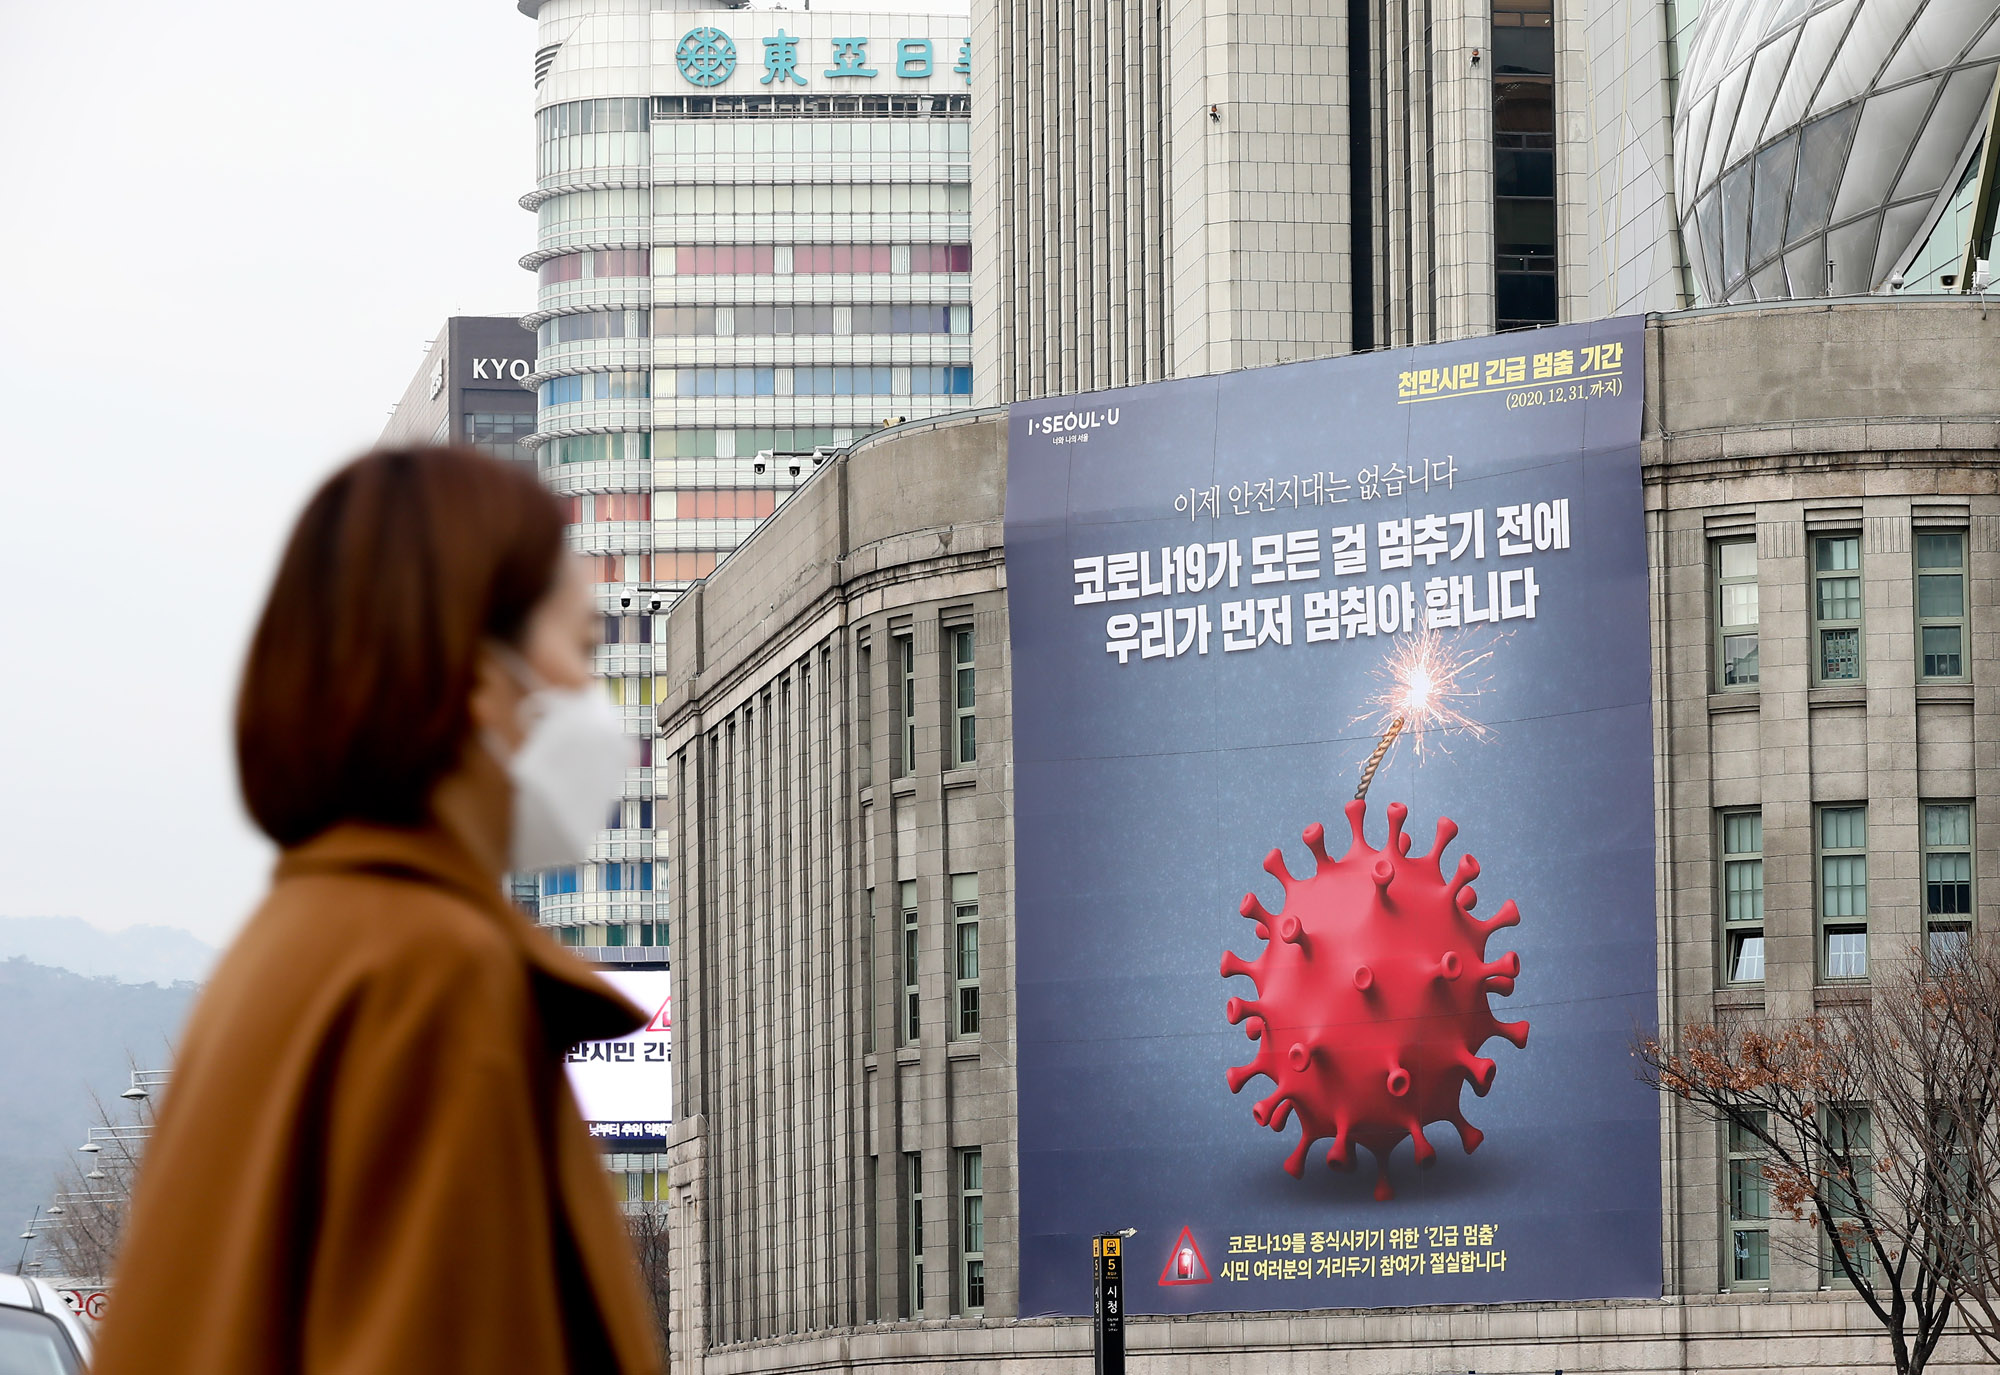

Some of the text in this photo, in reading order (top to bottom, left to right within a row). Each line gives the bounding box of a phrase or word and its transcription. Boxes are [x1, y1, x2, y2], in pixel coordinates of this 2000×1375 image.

[472, 358, 538, 380] KYO
[1398, 342, 1623, 397] 천만시민 긴급 멈춤 기간
[1052, 433, 1089, 445] 너와 나의 서울
[1174, 455, 1458, 522] 이제 안전지대는 없습니다
[1073, 498, 1570, 606] 코로나19가 모든 걸 멈추기 전에
[1106, 566, 1540, 664] 우리가 먼저 멈춰야 합니다
[564, 1042, 635, 1063] 만시민
[620, 1122, 643, 1137] 추위
[1227, 1232, 1306, 1255] 코로나19를
[1309, 1228, 1384, 1253] 종식시키기
[1388, 1226, 1420, 1250] 위한
[1107, 1258, 1116, 1270] 5
[1220, 1249, 1507, 1282] 시민 여러분의 거리두기 참여가 절실합니다
[1107, 1285, 1118, 1314] 시청
